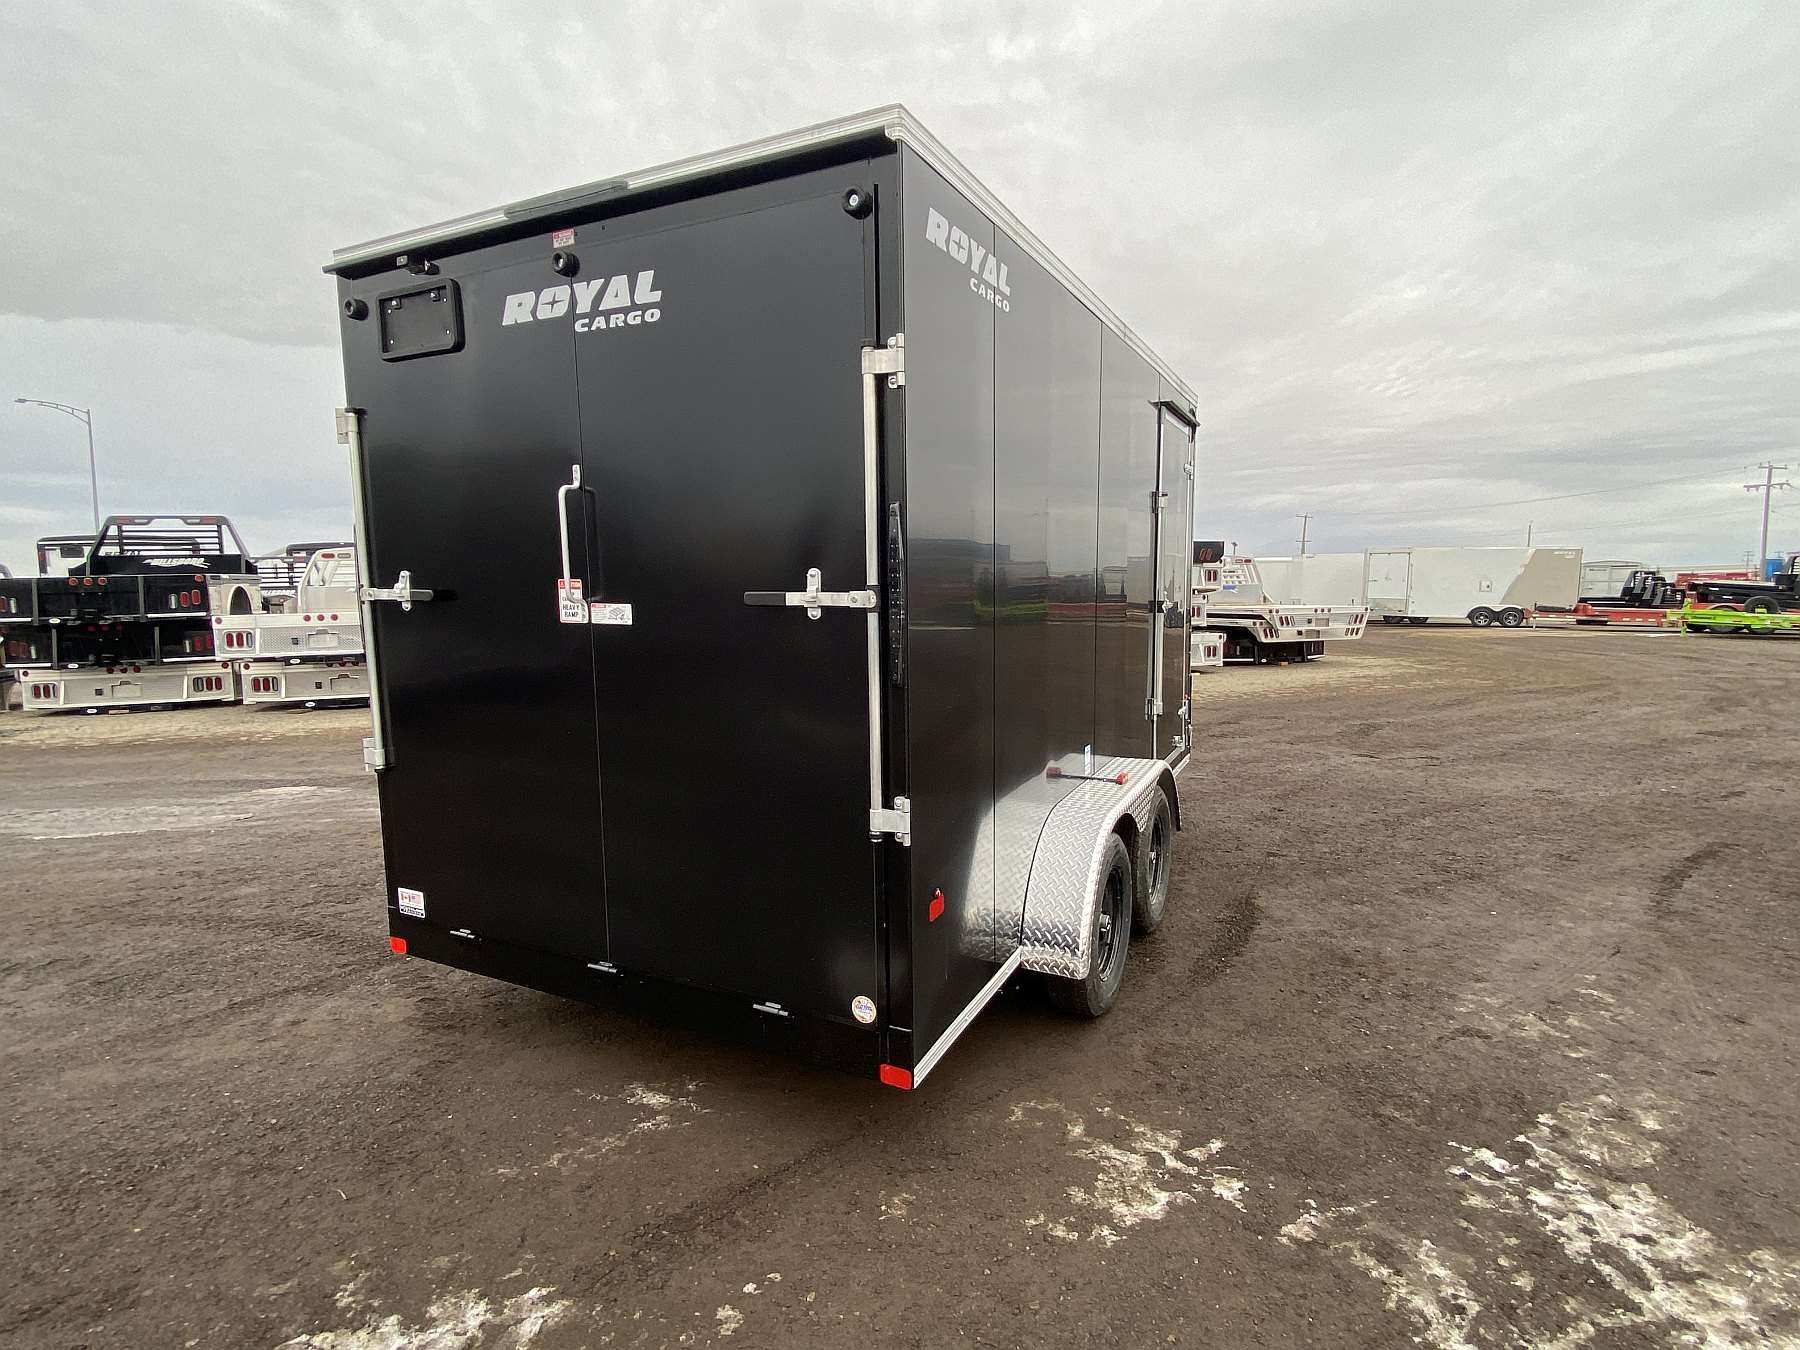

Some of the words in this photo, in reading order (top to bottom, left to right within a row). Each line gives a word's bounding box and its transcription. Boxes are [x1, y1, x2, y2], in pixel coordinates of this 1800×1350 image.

[925, 207, 1011, 297] ROYAL
[502, 269, 663, 326] ROYAL
[969, 277, 1010, 313] CARGO
[574, 308, 662, 333] CARGO
[562, 603, 580, 611] HEAVY
